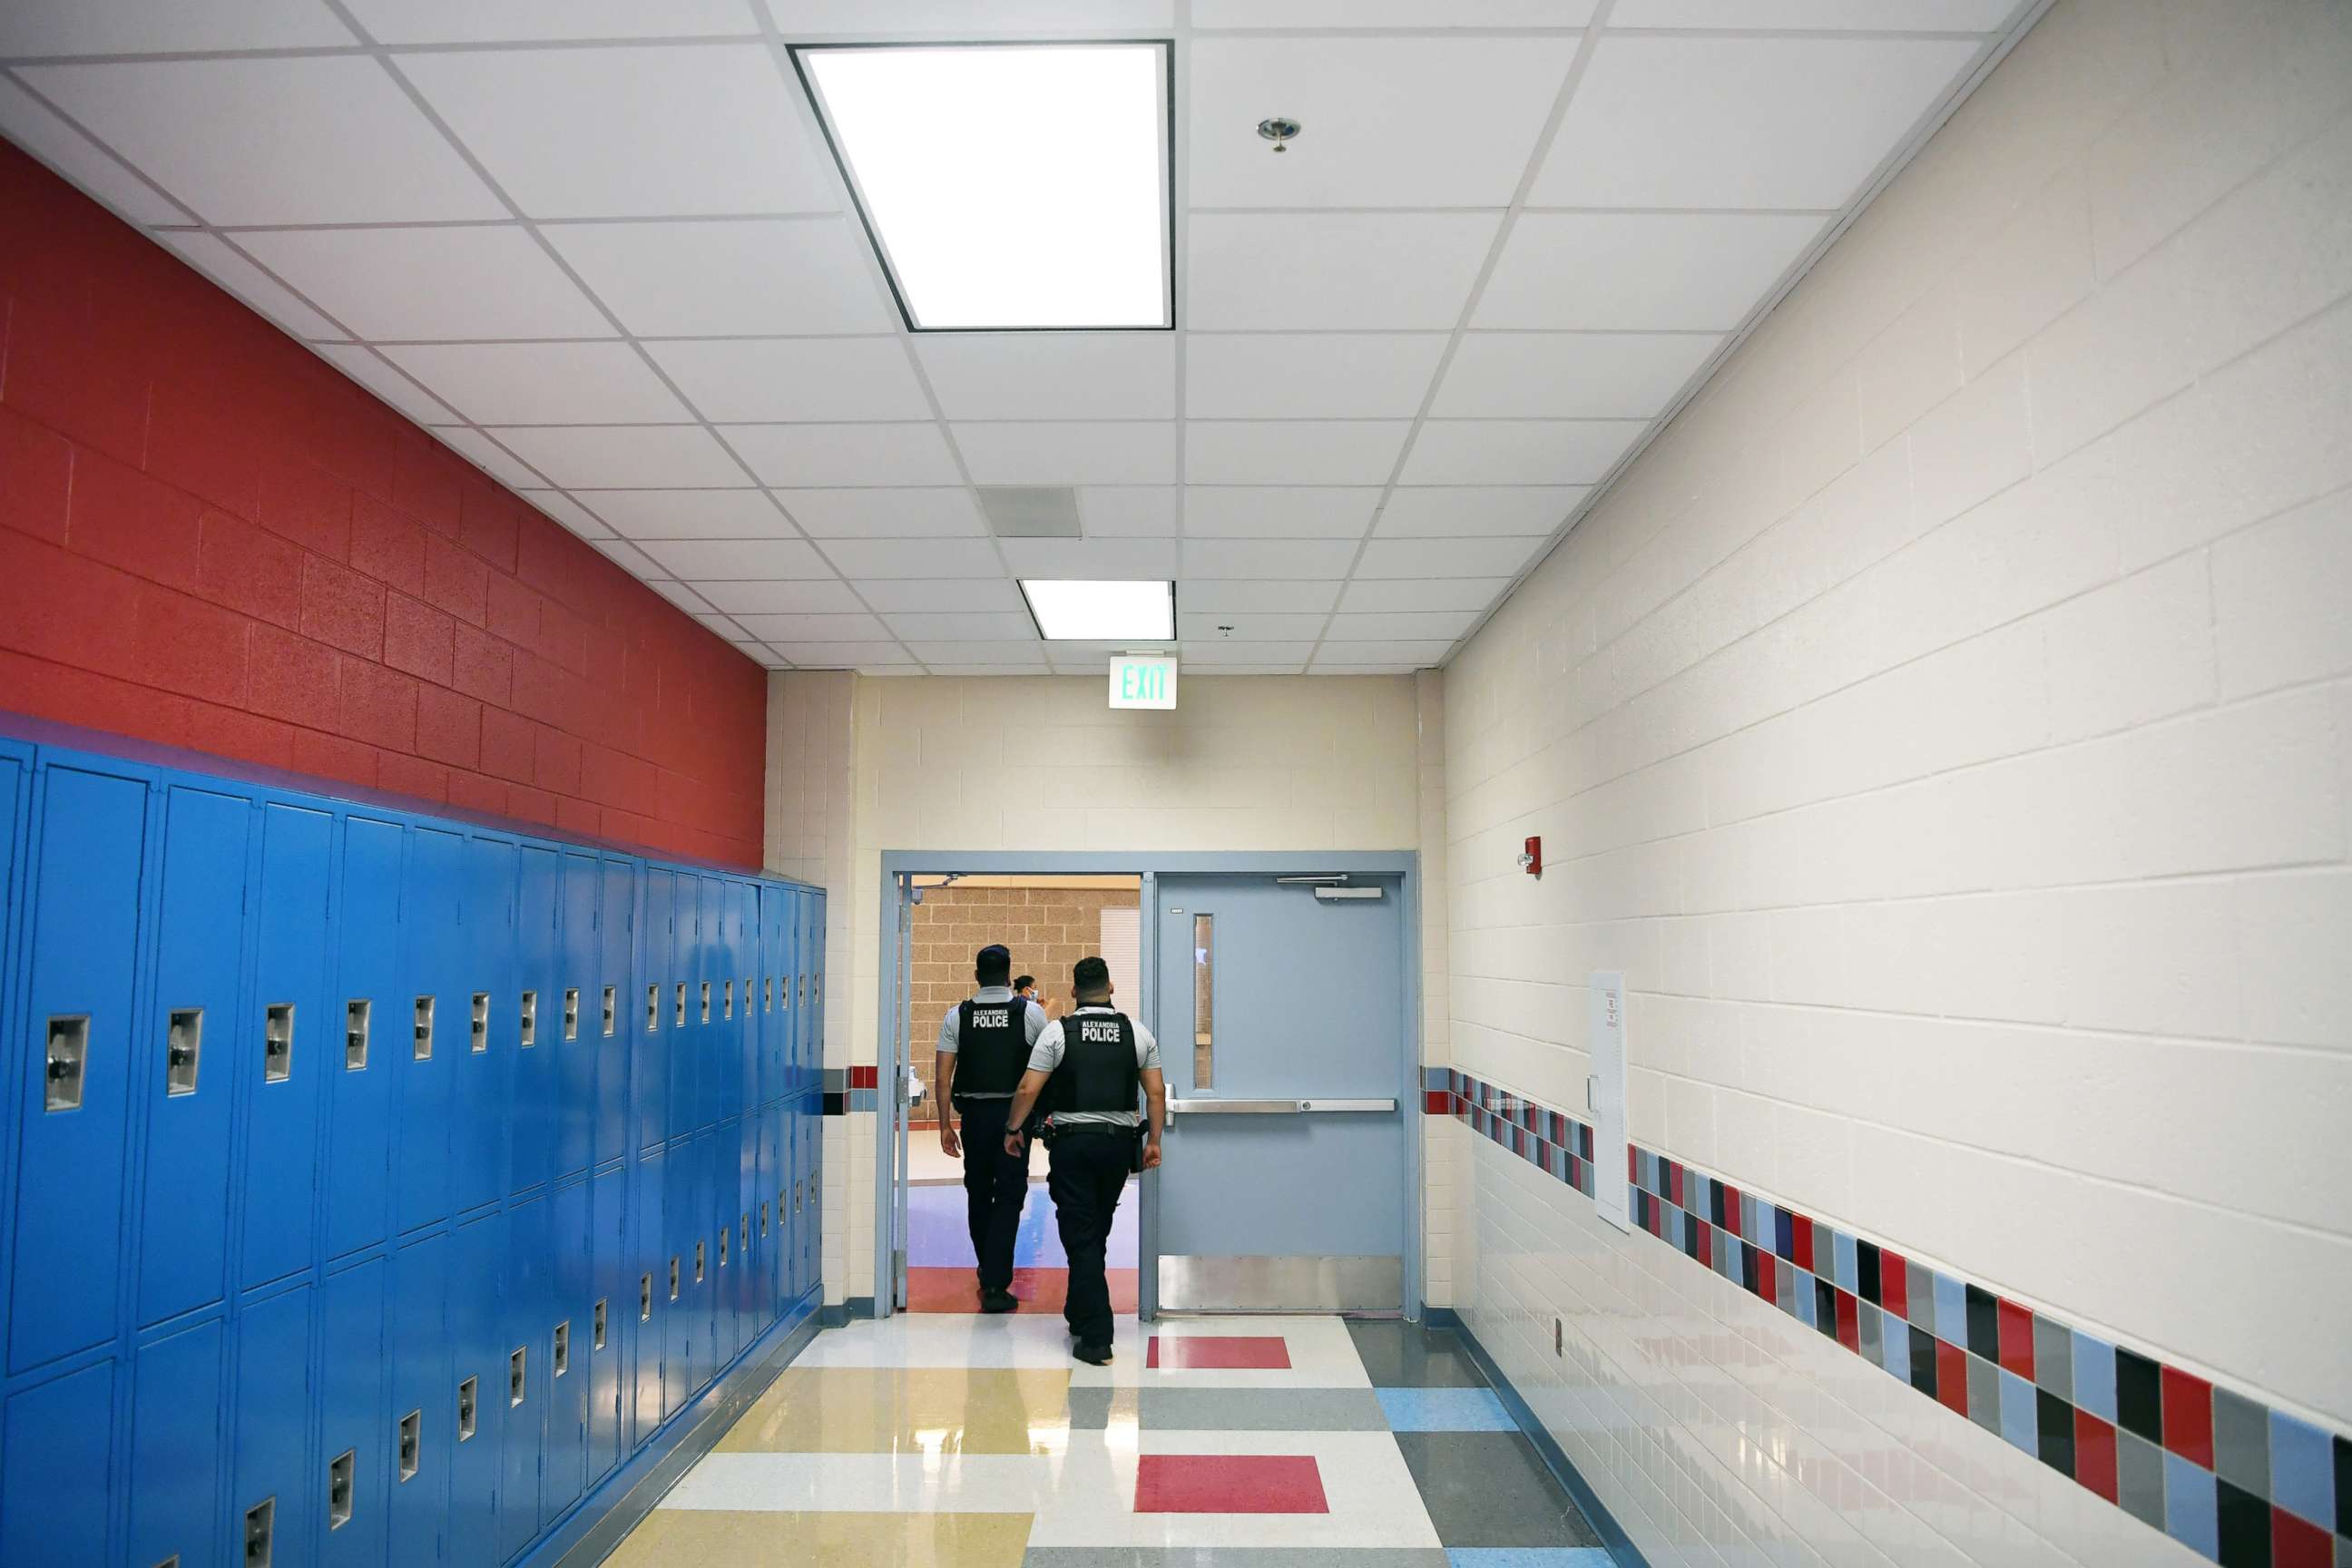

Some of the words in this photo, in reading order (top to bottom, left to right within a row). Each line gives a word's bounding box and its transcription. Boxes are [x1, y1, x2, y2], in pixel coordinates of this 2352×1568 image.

[1122, 663, 1166, 700] EXIT
[973, 1015, 1009, 1028] POLICE
[1082, 1021, 1120, 1029] ALEXANDRIA
[1082, 1027, 1121, 1043] POLICE
